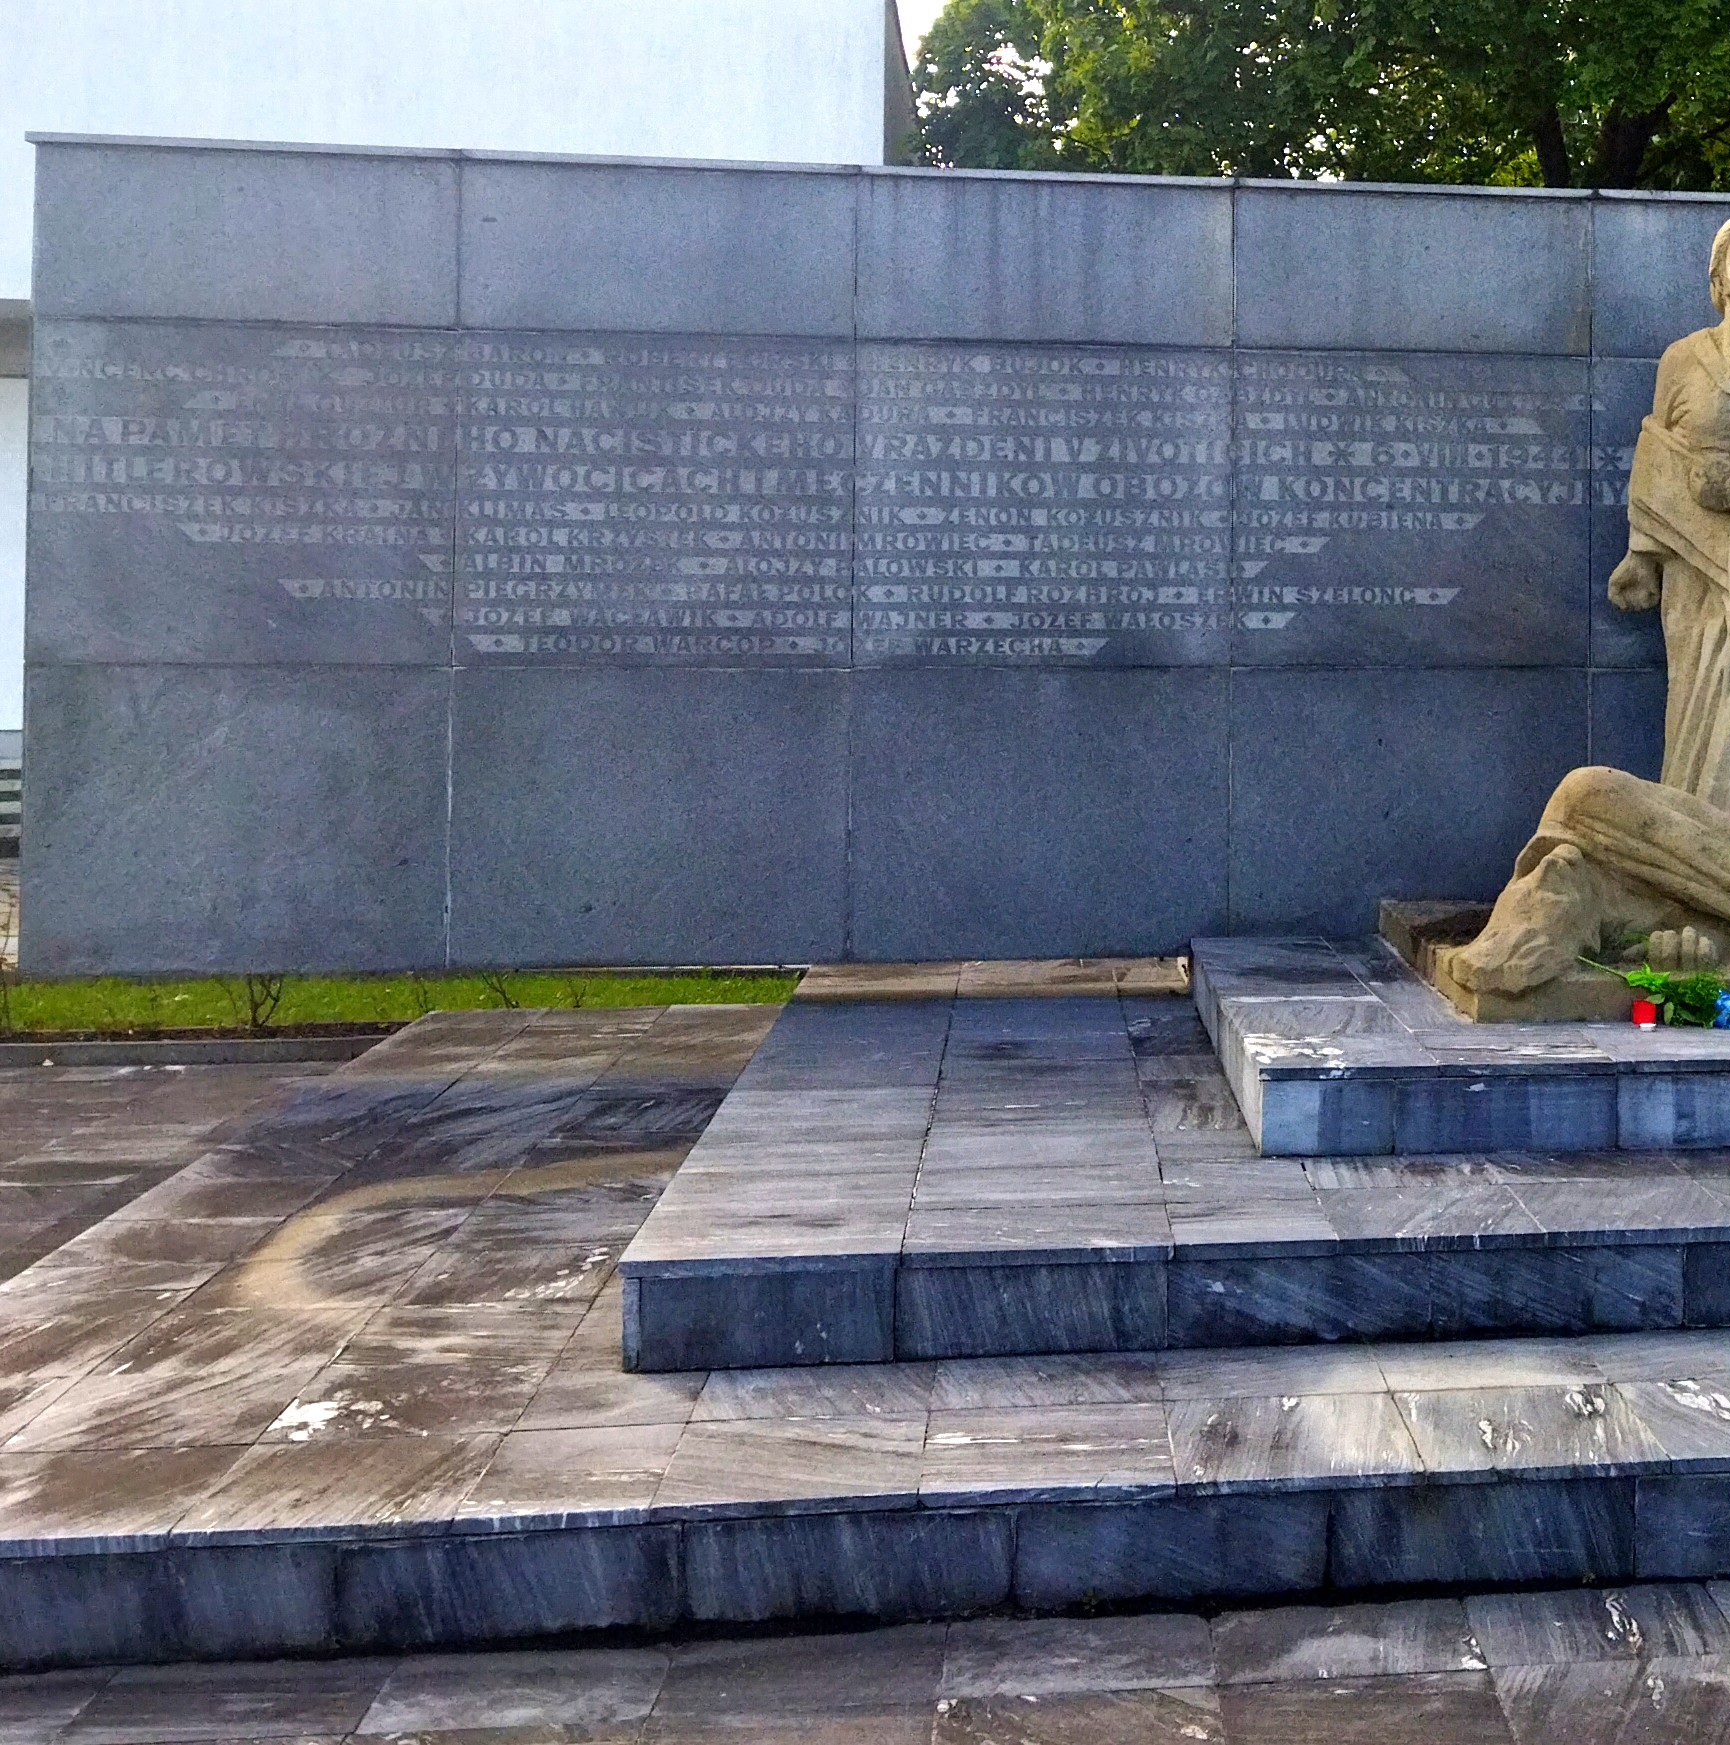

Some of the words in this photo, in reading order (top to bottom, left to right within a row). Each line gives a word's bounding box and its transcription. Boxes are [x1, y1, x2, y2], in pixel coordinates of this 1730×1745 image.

[1280, 477, 1633, 505] KONCENTRACYJNY
[467, 527, 557, 546] KAROL
[1018, 560, 1105, 577] KAROL
[523, 635, 640, 652] TEODOR
[912, 638, 1063, 654] WARZECHA
